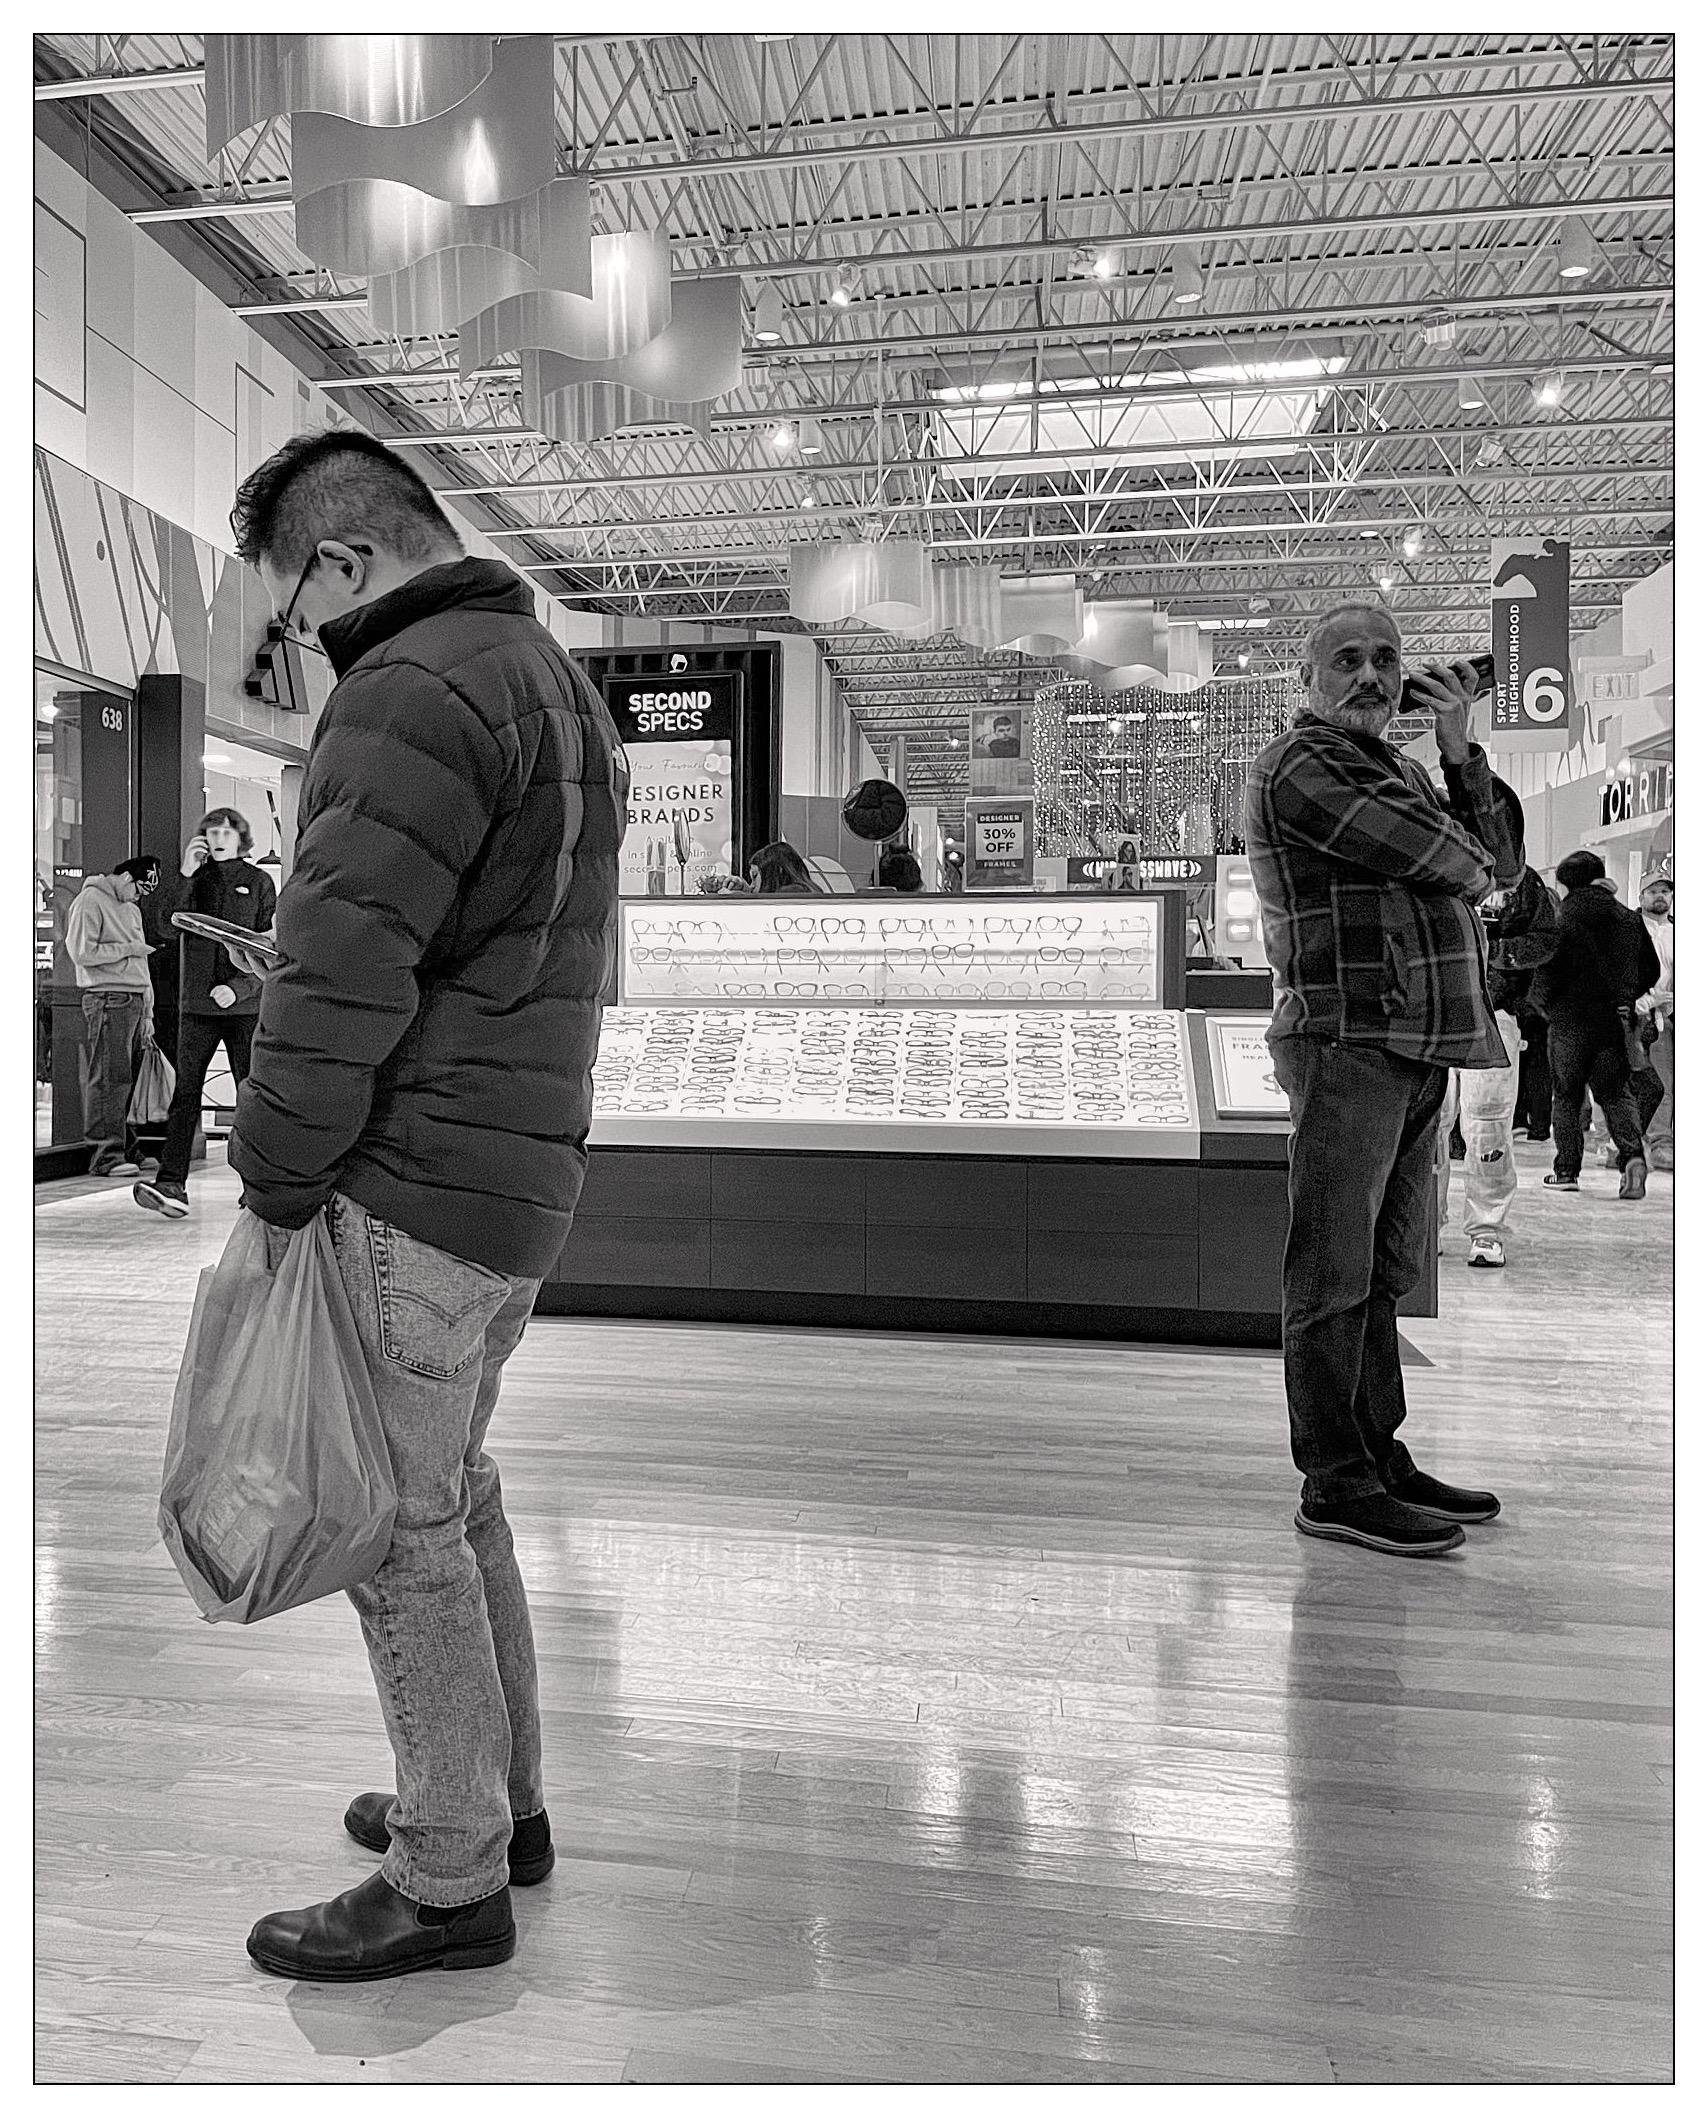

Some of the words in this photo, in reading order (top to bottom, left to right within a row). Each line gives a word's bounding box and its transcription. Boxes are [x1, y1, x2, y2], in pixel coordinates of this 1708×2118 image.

[1509, 604, 1520, 723] NEIGHBOURHOOD
[1523, 667, 1565, 722] 6
[1593, 674, 1635, 699] EXIT
[629, 691, 712, 712] SECOND
[1497, 681, 1507, 723] SPORT
[102, 706, 123, 731] 638
[637, 711, 704, 732] SPECS
[632, 784, 724, 802] ESIGNER
[983, 828, 1016, 840] 30%
[986, 842, 1015, 853] OFF
